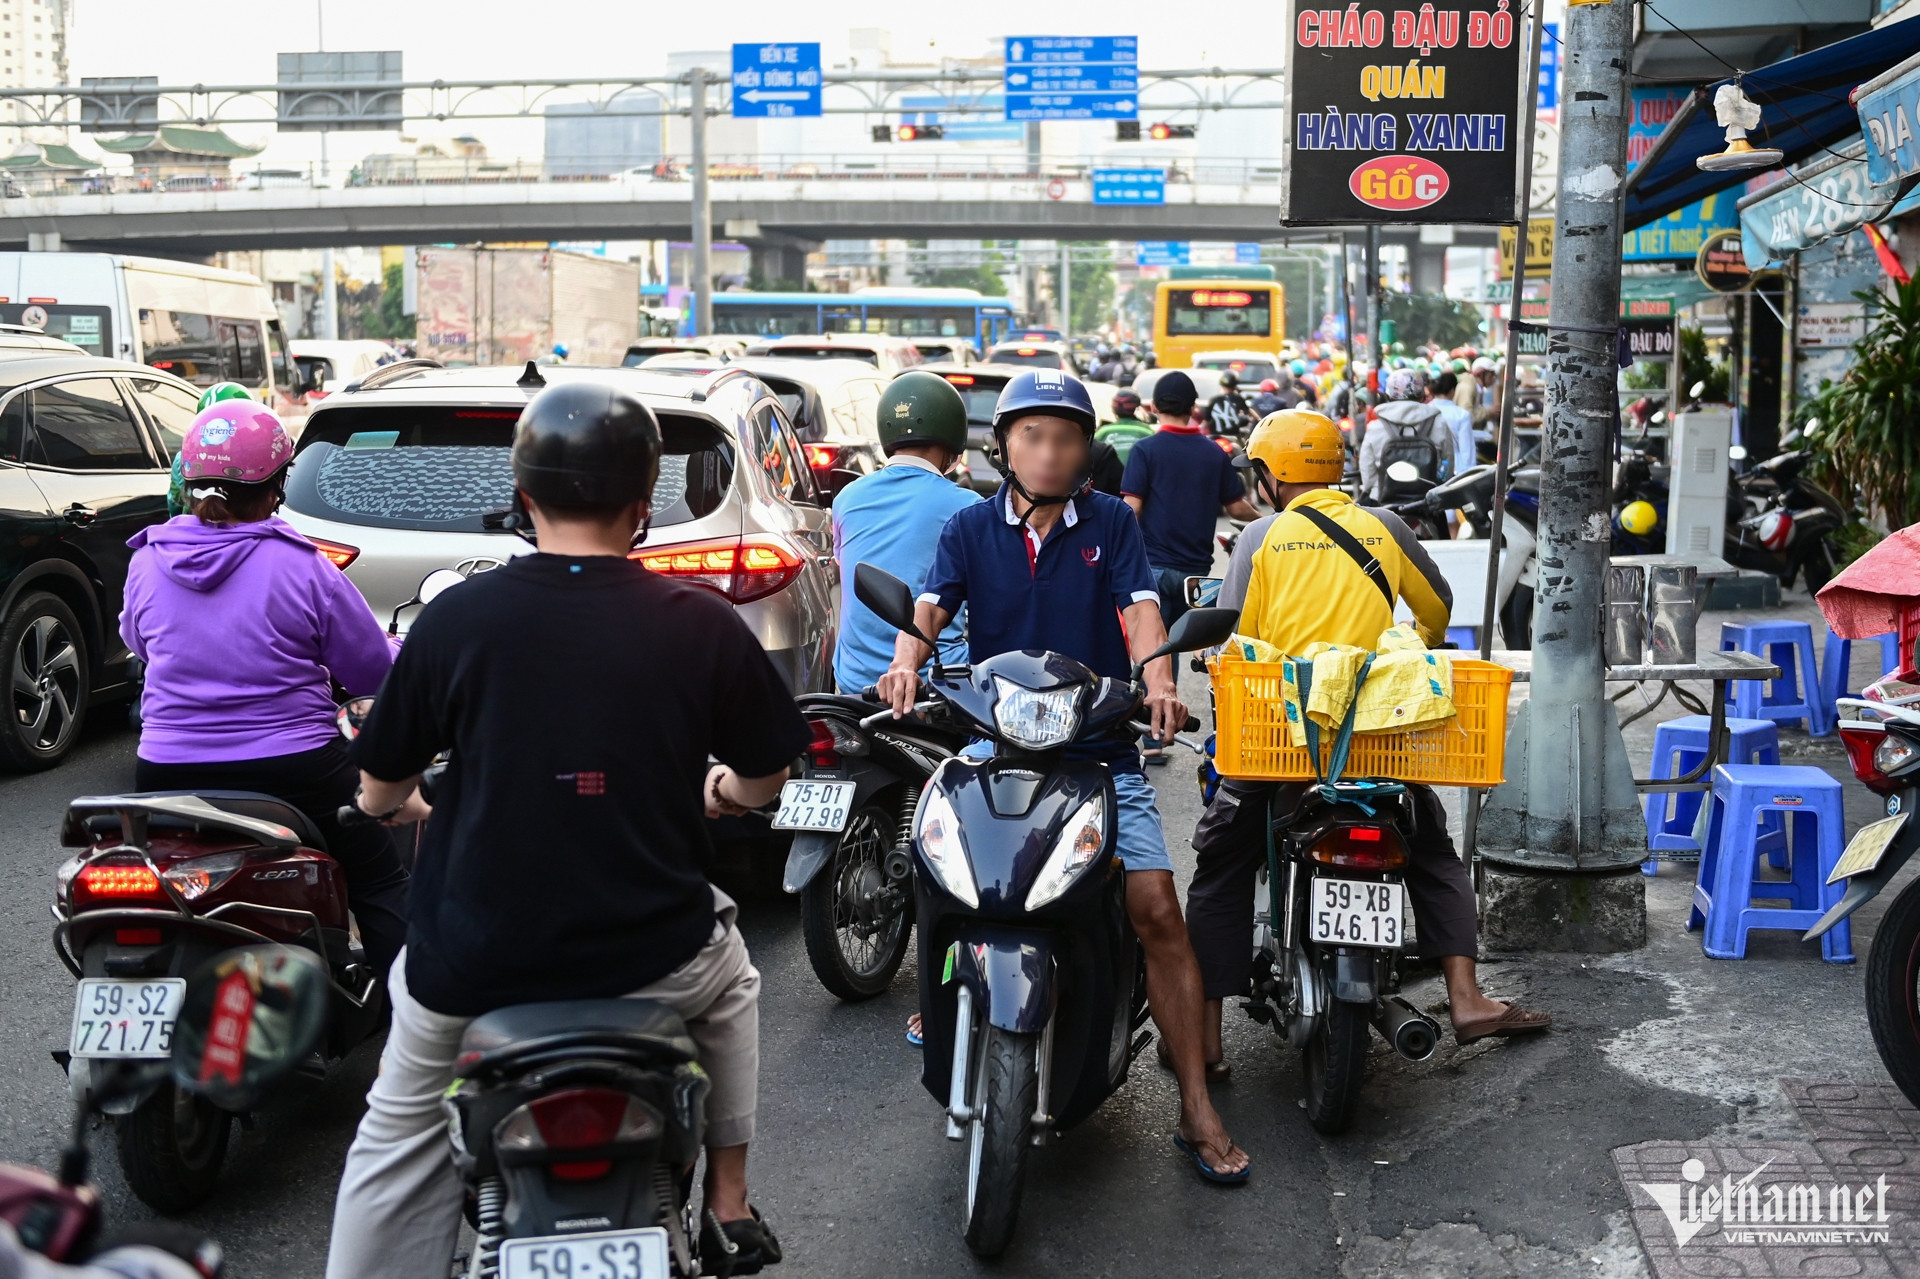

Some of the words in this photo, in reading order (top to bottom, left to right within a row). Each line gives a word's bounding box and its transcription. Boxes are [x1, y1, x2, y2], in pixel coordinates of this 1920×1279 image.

[1297, 3, 1384, 48] CHÁO
[1392, 3, 1460, 56] ĐẬU
[1467, 0, 1513, 48] ĐỎ
[760, 43, 783, 64] BẾN
[784, 46, 799, 64] XE
[734, 66, 761, 87] MIỀN
[764, 68, 794, 87] ĐÔNG
[796, 66, 819, 87] MỚI
[1360, 59, 1446, 102] QUÁN
[1297, 105, 1397, 150] HÀNG
[1405, 114, 1506, 151] XANH
[1802, 167, 1863, 238] 283
[199, 424, 238, 437] Hygiene
[217, 453, 231, 462] kids
[1272, 541, 1337, 553] VIETNAM
[874, 731, 923, 756] BLADE
[998, 768, 1035, 776] HONDA
[778, 806, 844, 828] 247.98
[252, 869, 300, 881] LEAD
[1325, 881, 1391, 912] 59-XB
[1318, 911, 1397, 944] 546.13
[93, 985, 169, 1016] 59-S2
[78, 1020, 175, 1052] 721.75
[530, 1241, 642, 1279] 59-S3
